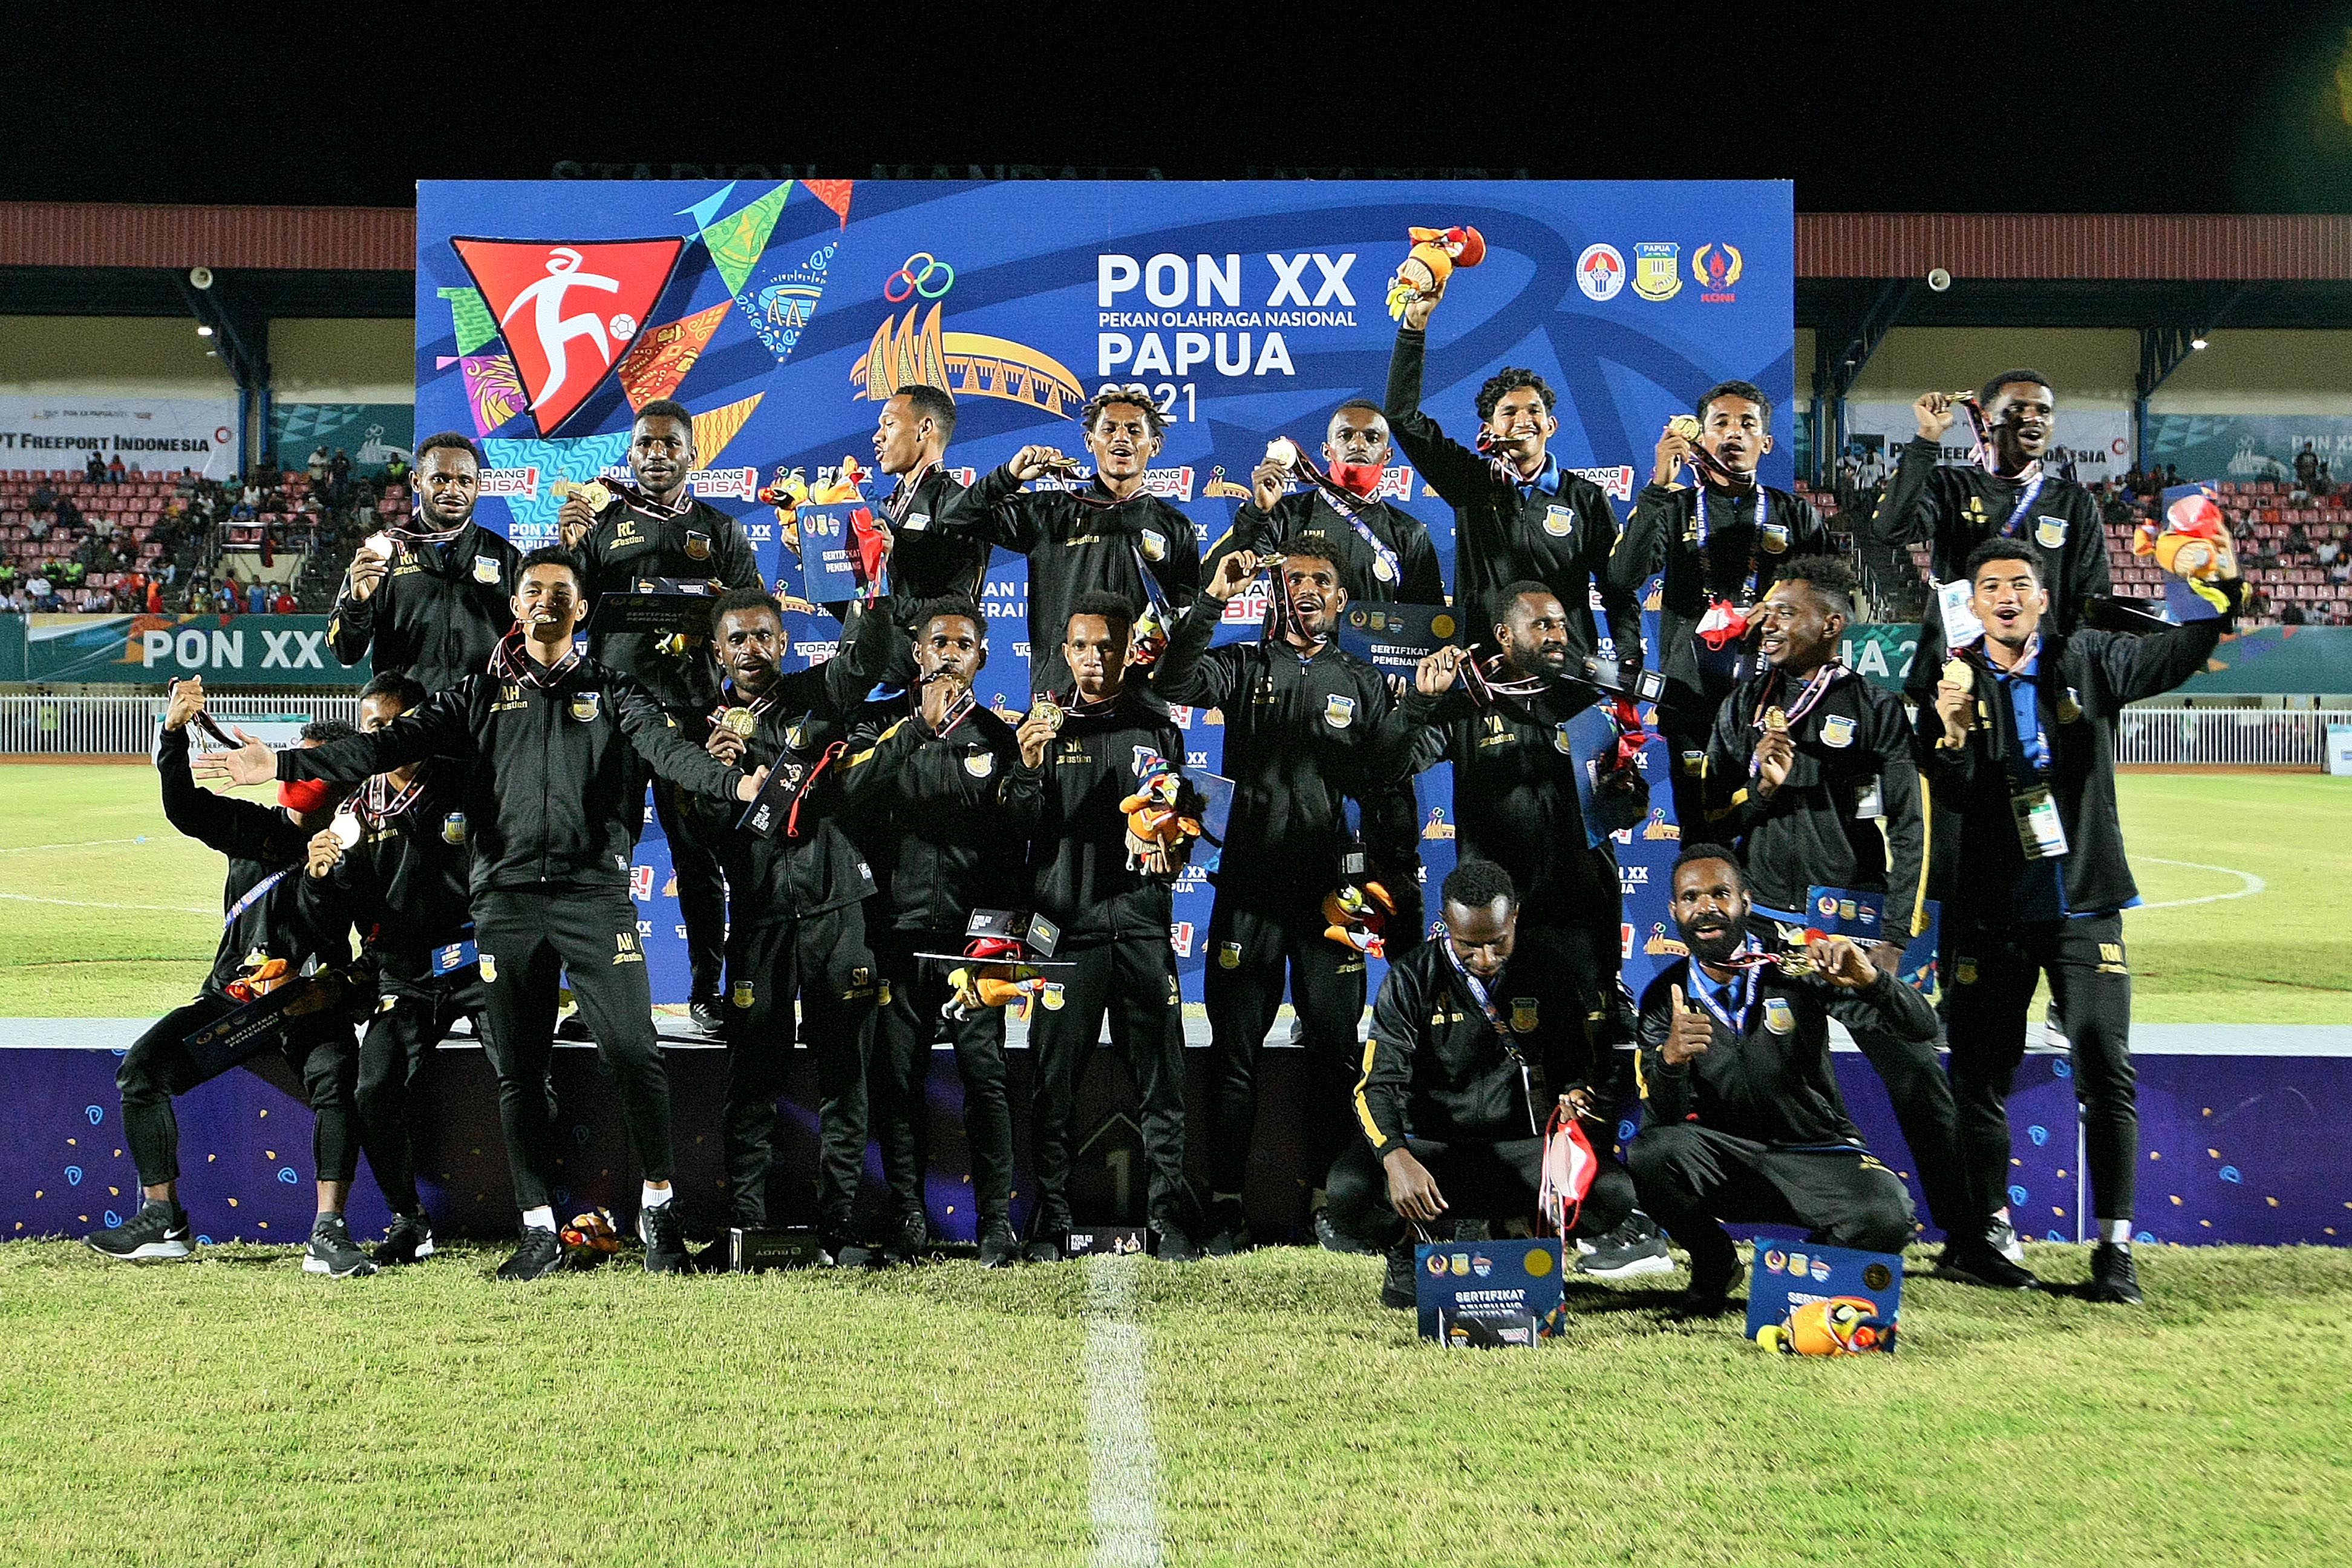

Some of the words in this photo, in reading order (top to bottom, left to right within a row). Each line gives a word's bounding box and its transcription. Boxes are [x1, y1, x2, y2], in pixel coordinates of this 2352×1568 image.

[1098, 253, 1241, 309] PON
[1267, 253, 1357, 309] XX
[1099, 312, 1158, 327] PEKAN
[1161, 312, 1263, 327] OLAHRAGA
[1266, 312, 1357, 327] NASIONAL
[1098, 332, 1295, 376] PAPUA
[0, 433, 17, 448] T
[20, 433, 110, 451] FREEPORT
[113, 434, 209, 452] INDONESIA
[599, 466, 632, 478] PON
[509, 523, 540, 536] PON
[616, 520, 636, 538] RC
[143, 629, 243, 668] PON
[260, 629, 324, 668] XX
[797, 644, 838, 653] TORA
[1370, 644, 1430, 656] SERTIFIKAT
[1372, 656, 1420, 667] PEMENAN
[502, 685, 520, 701] AH
[1484, 715, 1504, 734] YA
[1186, 751, 1208, 764] XX
[1187, 865, 1207, 878] XX
[1627, 866, 1649, 880] XX
[616, 932, 636, 952] AH
[1455, 1289, 1526, 1303] SERTIFIKAT
